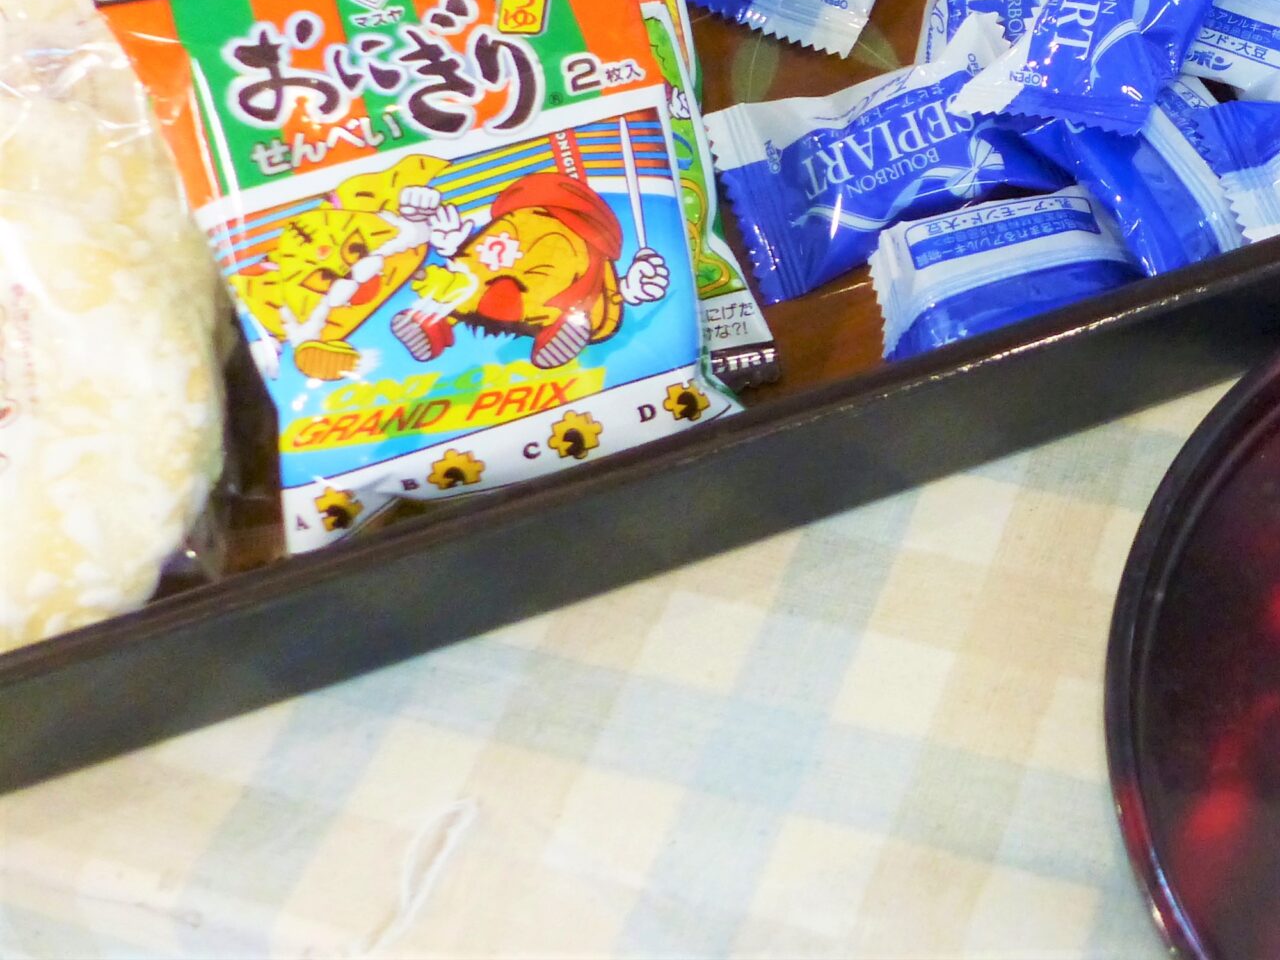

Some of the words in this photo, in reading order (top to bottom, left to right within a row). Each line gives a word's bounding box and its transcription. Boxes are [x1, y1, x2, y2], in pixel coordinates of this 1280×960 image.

[350, 7, 406, 28] マスヤ
[1009, 71, 1044, 87] OPEN
[252, 112, 405, 176] せんべい
[801, 92, 977, 202] SEPIART
[847, 147, 939, 198] BOURBON
[925, 196, 1072, 235] 乳・アーモンド・大豆
[292, 400, 452, 448] GRAND
[466, 378, 577, 421] PRIX
[637, 403, 657, 423] D
[523, 442, 542, 460] C
[401, 478, 421, 492] B
